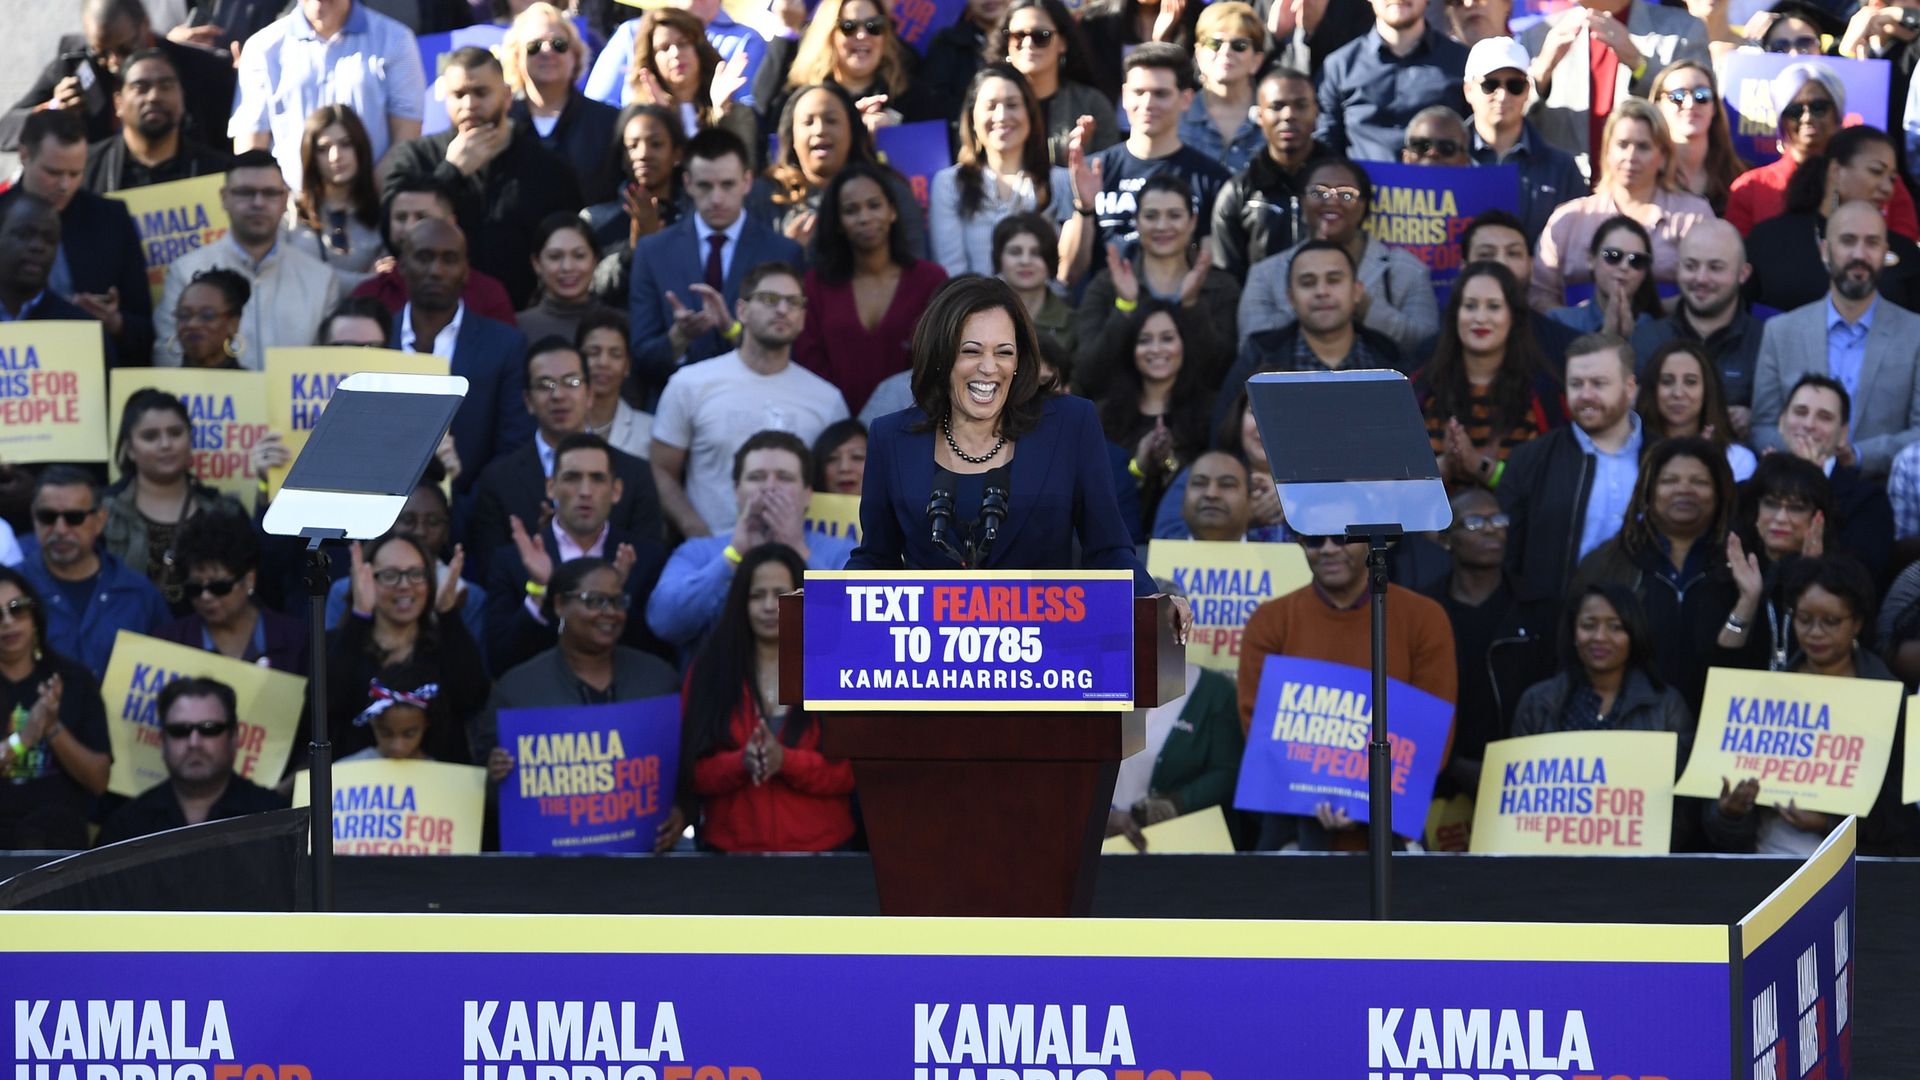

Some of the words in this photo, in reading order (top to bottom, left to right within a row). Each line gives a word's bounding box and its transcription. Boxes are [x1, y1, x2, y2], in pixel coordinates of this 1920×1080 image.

[31, 370, 78, 396] FOR
[0, 398, 81, 425] EOPLE
[846, 586, 924, 621] TEXT
[933, 586, 1086, 621] FEARLESS
[1190, 597, 1261, 626] ARRIS
[890, 627, 931, 662] TO
[939, 627, 1043, 663] 70785
[839, 669, 1093, 689] KAMALAHARRIS.ORG
[1278, 681, 1372, 725] KAMAL
[1727, 696, 1831, 731] KAMALA
[518, 728, 625, 766] KAMALA
[1271, 711, 1368, 751] HARRIS
[1368, 730, 1417, 769] OR
[1721, 726, 1815, 757] HARRIS
[1815, 733, 1865, 762] FOR
[520, 762, 616, 798] HARRIS
[615, 755, 660, 791] FOR
[1503, 756, 1607, 788] KAMALA
[1734, 754, 1764, 771] THE
[1761, 758, 1858, 788] PEOPLE
[333, 785, 417, 812] AMALA
[569, 785, 660, 827] PEOPLE
[1499, 787, 1594, 816] HARRIS
[1595, 788, 1645, 818] FOR
[404, 815, 454, 845] FOR
[1515, 816, 1543, 833] THE
[1545, 816, 1642, 847] PEOPLE
[15, 1000, 235, 1060] KAMALA
[464, 1001, 685, 1062] KAMALA
[914, 1003, 1137, 1065] KAMALA
[1753, 981, 1779, 1060] KAMALA
[1368, 1008, 1594, 1071] KAMALA
